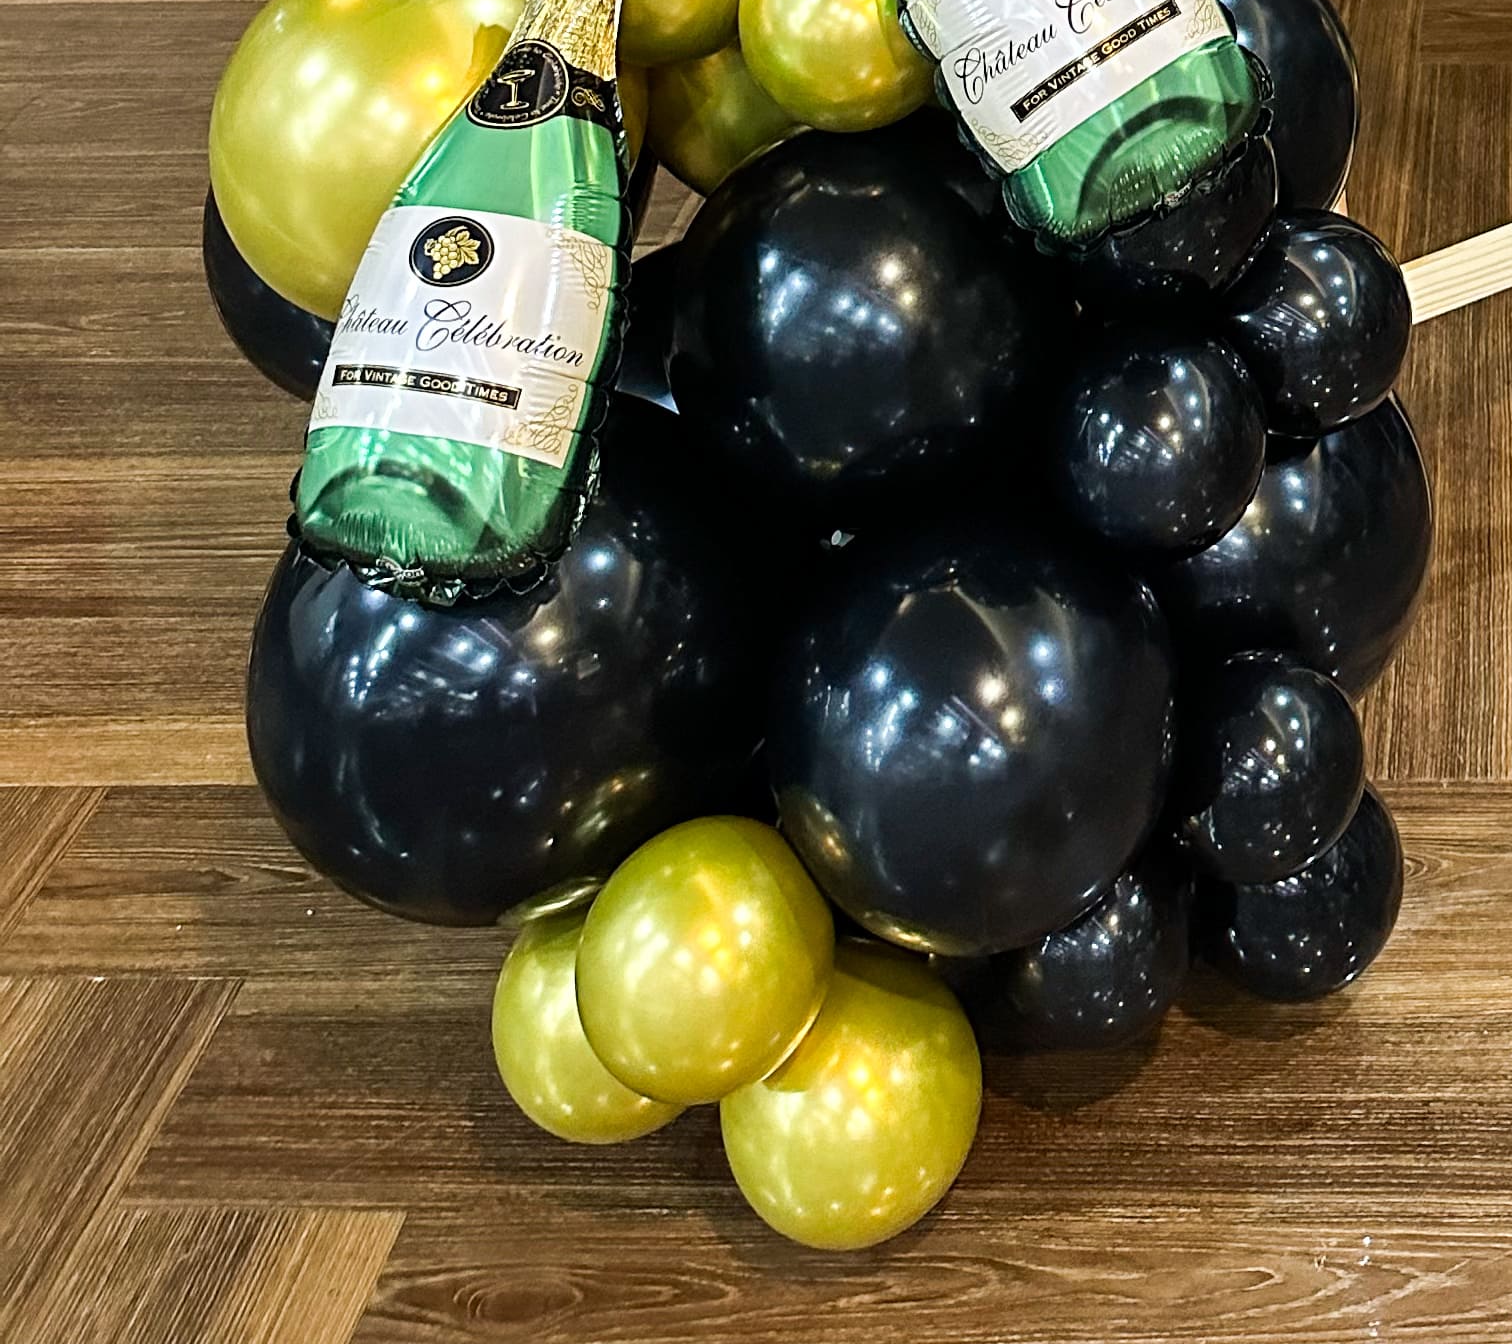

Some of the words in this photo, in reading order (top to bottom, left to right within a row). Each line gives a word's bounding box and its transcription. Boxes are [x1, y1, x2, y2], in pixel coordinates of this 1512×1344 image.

[953, 23, 1058, 105] Château
[1022, 88, 1049, 112] FOR
[1101, 27, 1138, 56] GOOD
[1137, 6, 1171, 31] TIMES
[416, 298, 584, 367] Célébration
[465, 381, 509, 402] TIMES
